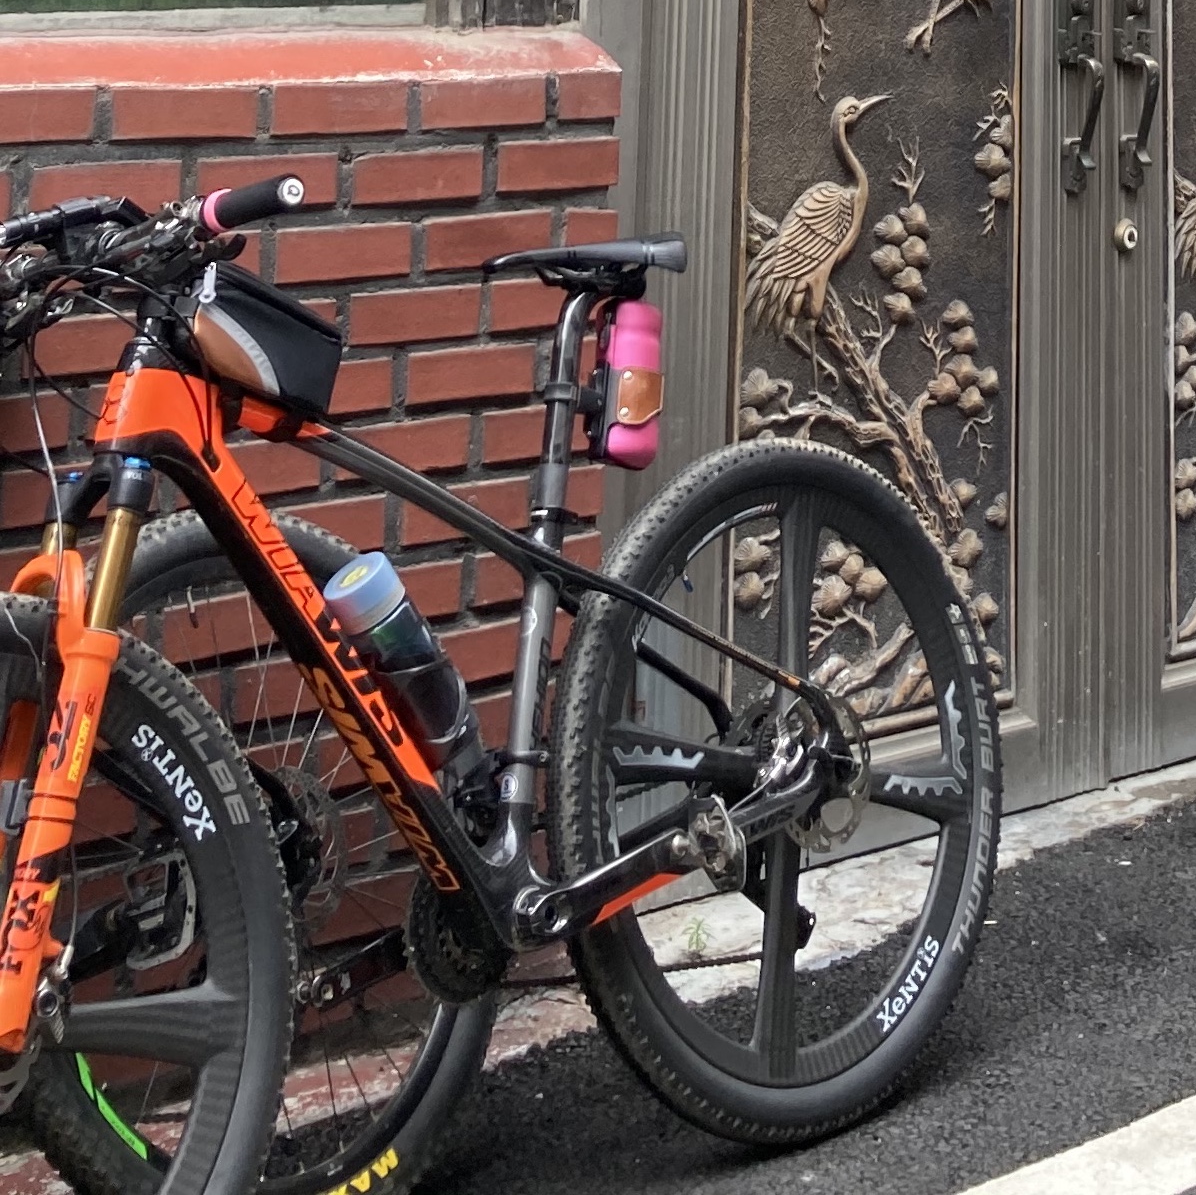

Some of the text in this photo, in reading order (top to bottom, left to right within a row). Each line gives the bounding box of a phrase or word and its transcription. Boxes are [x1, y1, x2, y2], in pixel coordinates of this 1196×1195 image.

[232, 478, 403, 747] WIAWIS
[67, 713, 92, 782] FACTORY
[112, 657, 250, 825] HWALBE
[951, 677, 994, 955] THUNDER BURT
